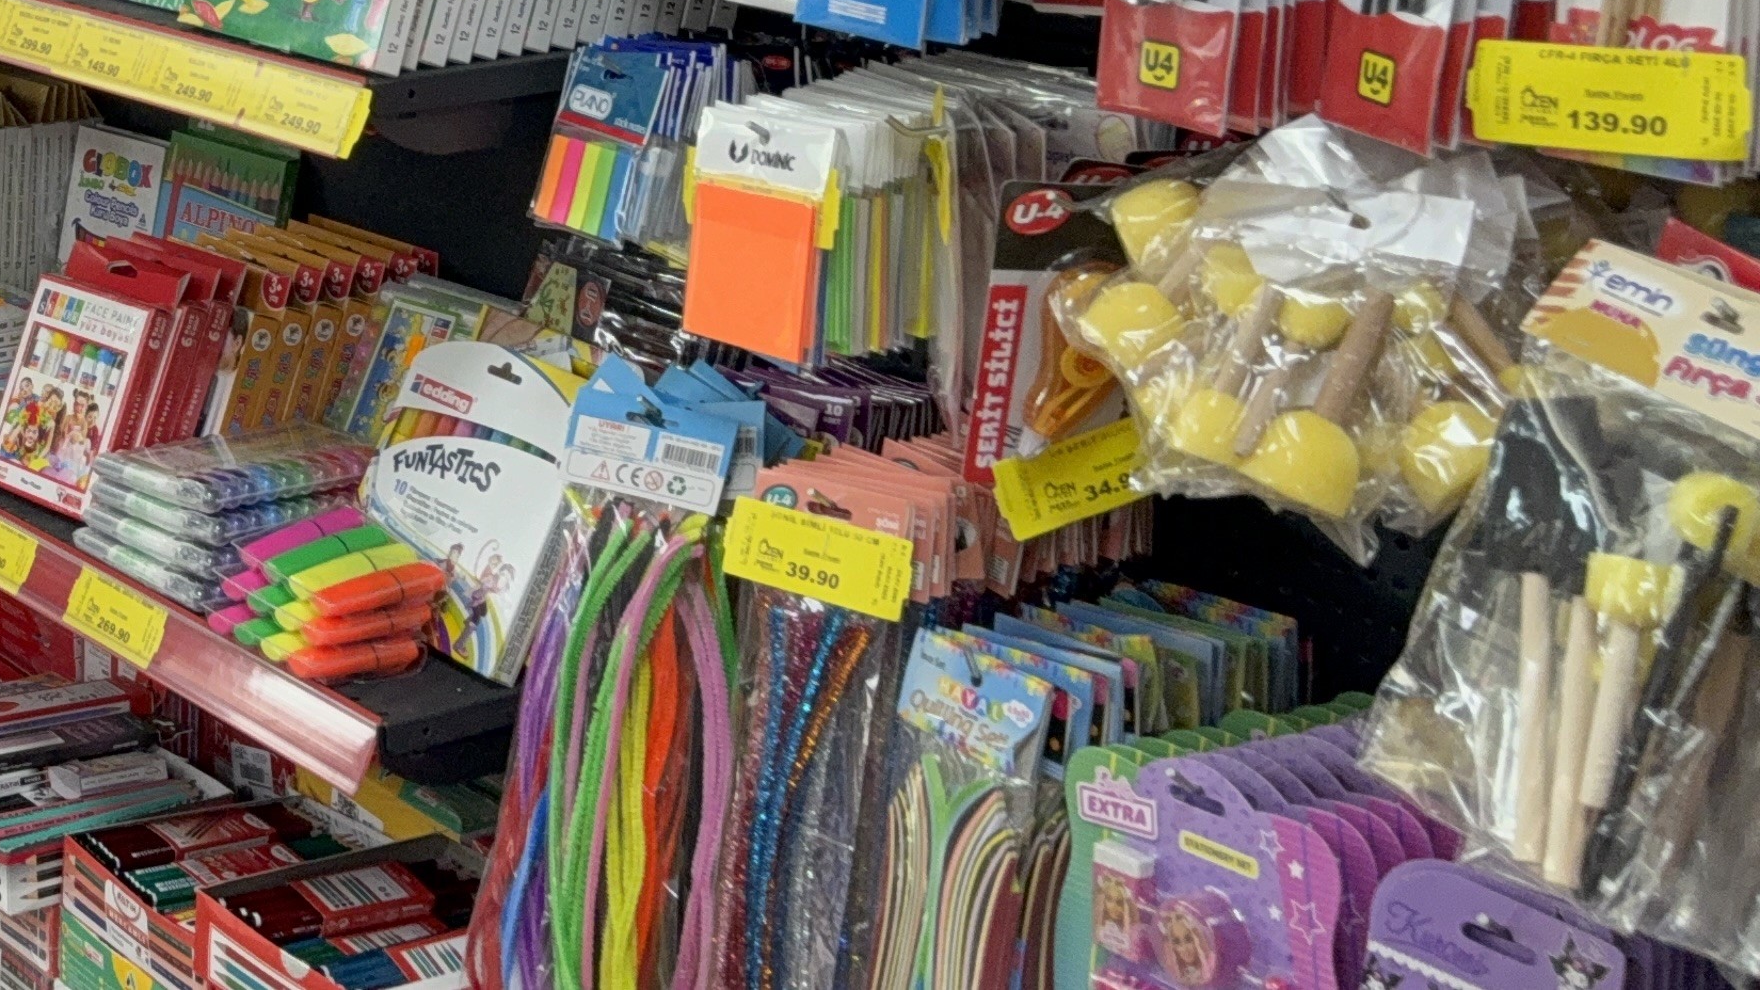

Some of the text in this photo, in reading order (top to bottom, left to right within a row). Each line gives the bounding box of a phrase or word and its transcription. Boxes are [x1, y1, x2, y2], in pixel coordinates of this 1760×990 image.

[86, 58, 121, 79] 149.90
[1145, 48, 1174, 74] U4
[1363, 59, 1391, 89] U4
[174, 80, 214, 104] 249.90
[280, 110, 323, 135] 249.90
[1567, 110, 1667, 137] 139.90
[1011, 197, 1066, 224] U-4
[423, 382, 474, 414] edding
[393, 441, 502, 493] FUNTASTICS
[1082, 471, 1130, 501] 34.9
[785, 560, 840, 592] 39.90
[97, 616, 133, 645] 269.90
[1086, 793, 1148, 827] EXTRA
